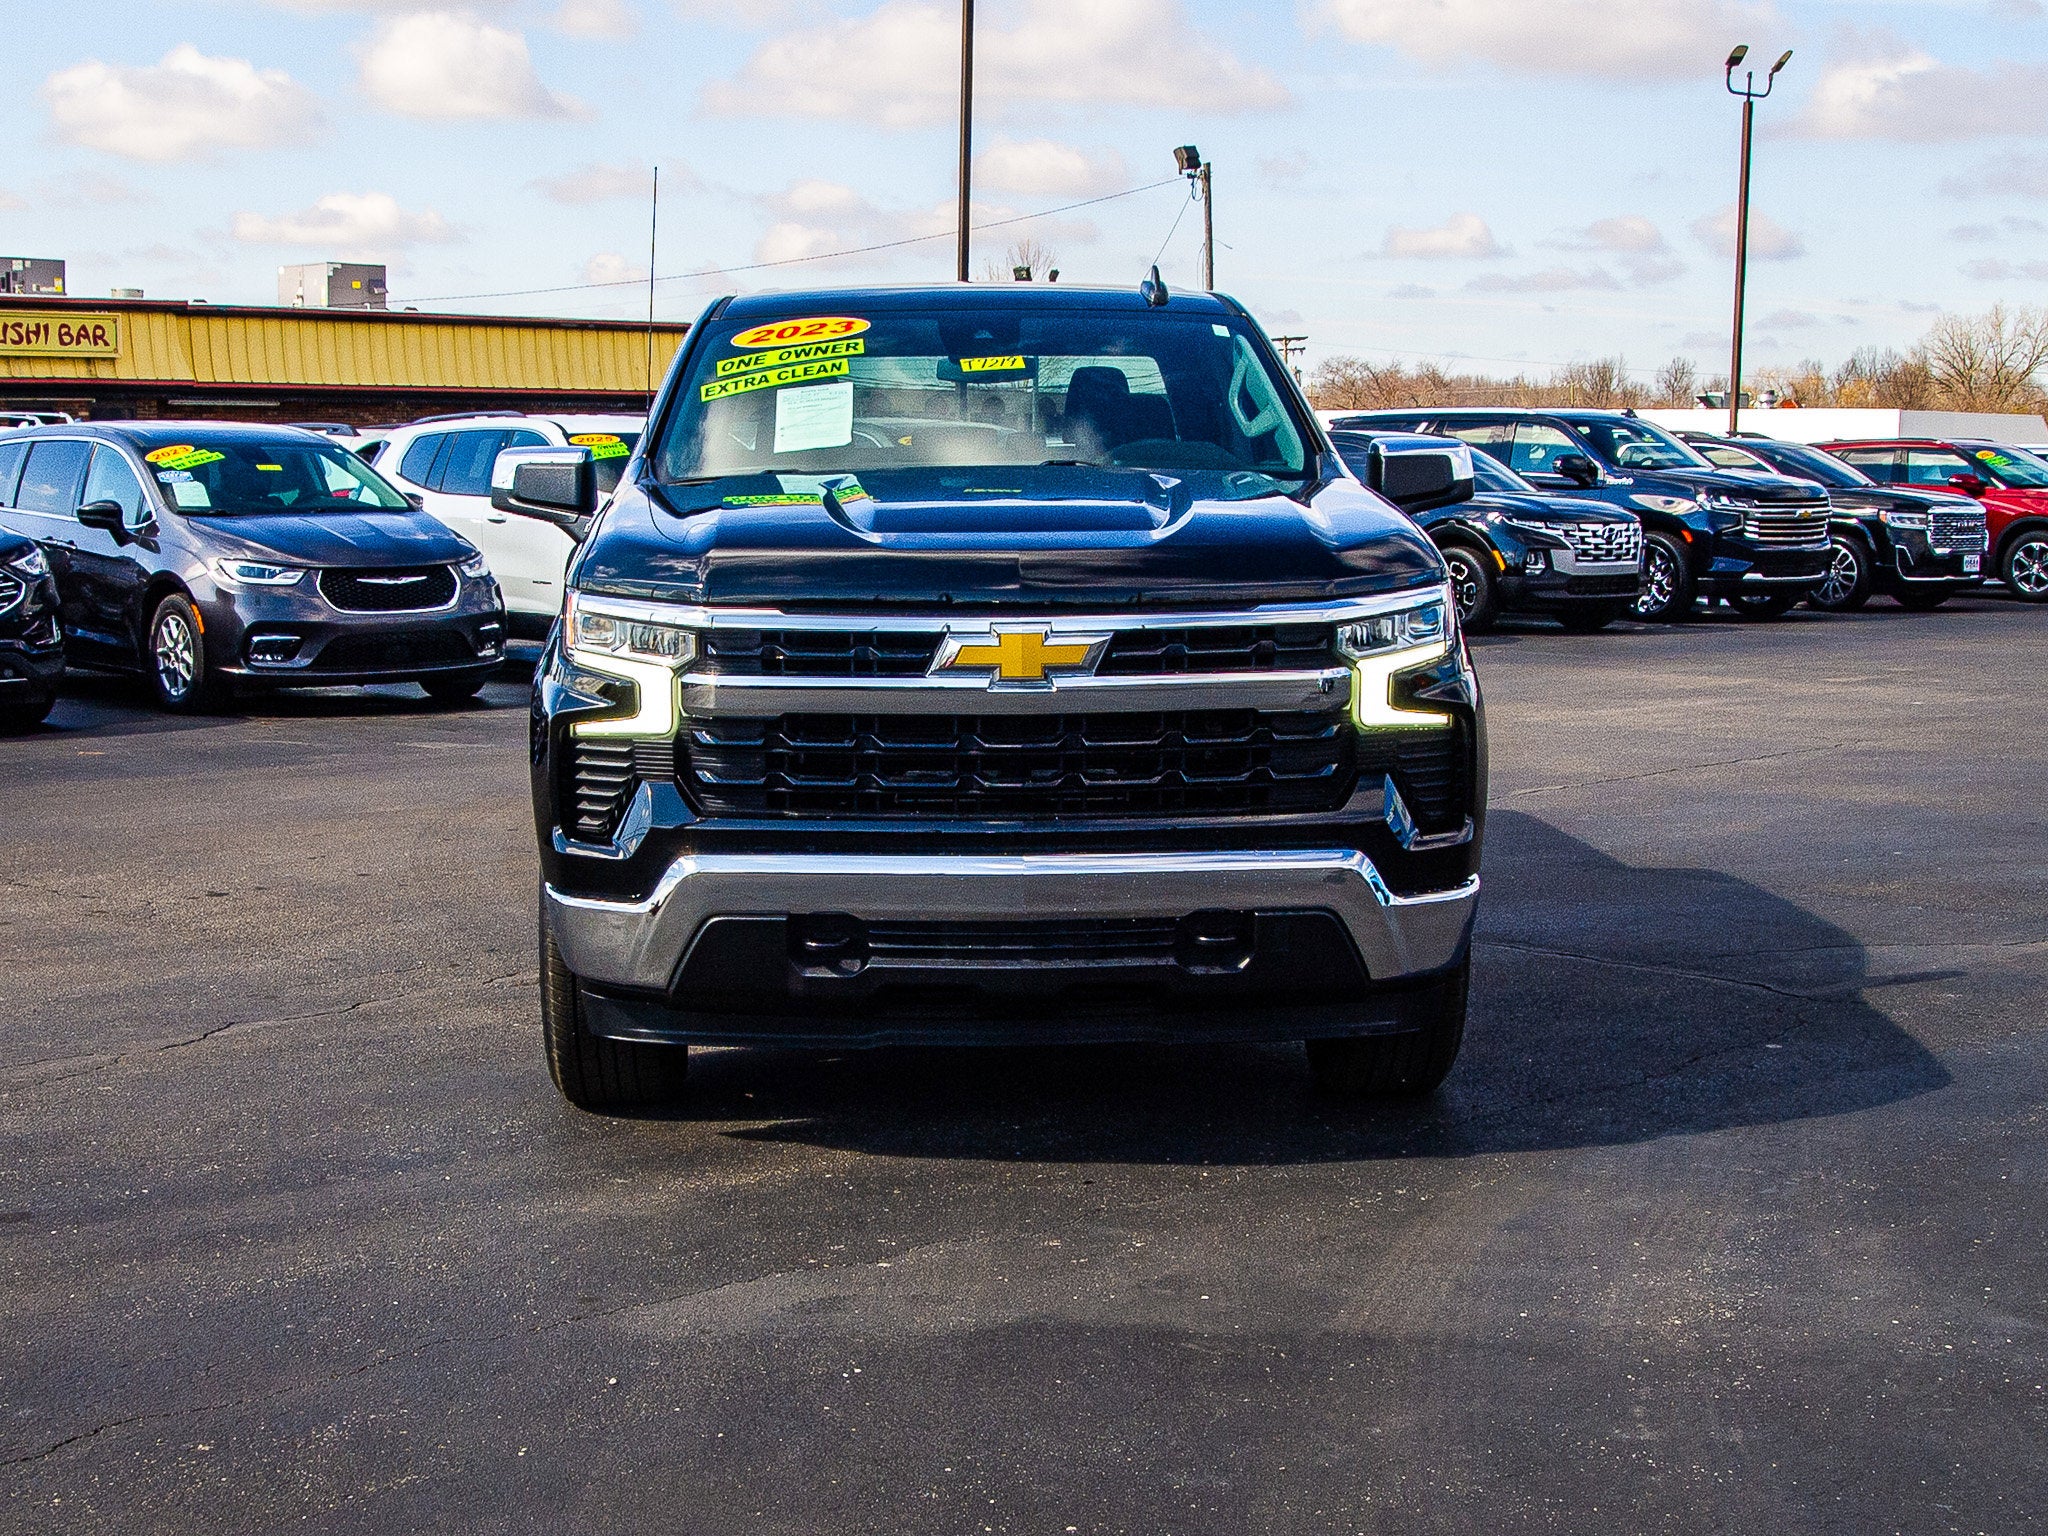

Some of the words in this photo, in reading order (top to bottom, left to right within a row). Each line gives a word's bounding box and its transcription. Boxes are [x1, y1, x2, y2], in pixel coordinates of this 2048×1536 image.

[57, 322, 111, 347] BAR
[747, 321, 857, 345] 2023
[721, 354, 767, 372] ONE
[778, 341, 860, 361] OWNER
[704, 374, 770, 398] EXTRA
[777, 361, 843, 381] CLEAN
